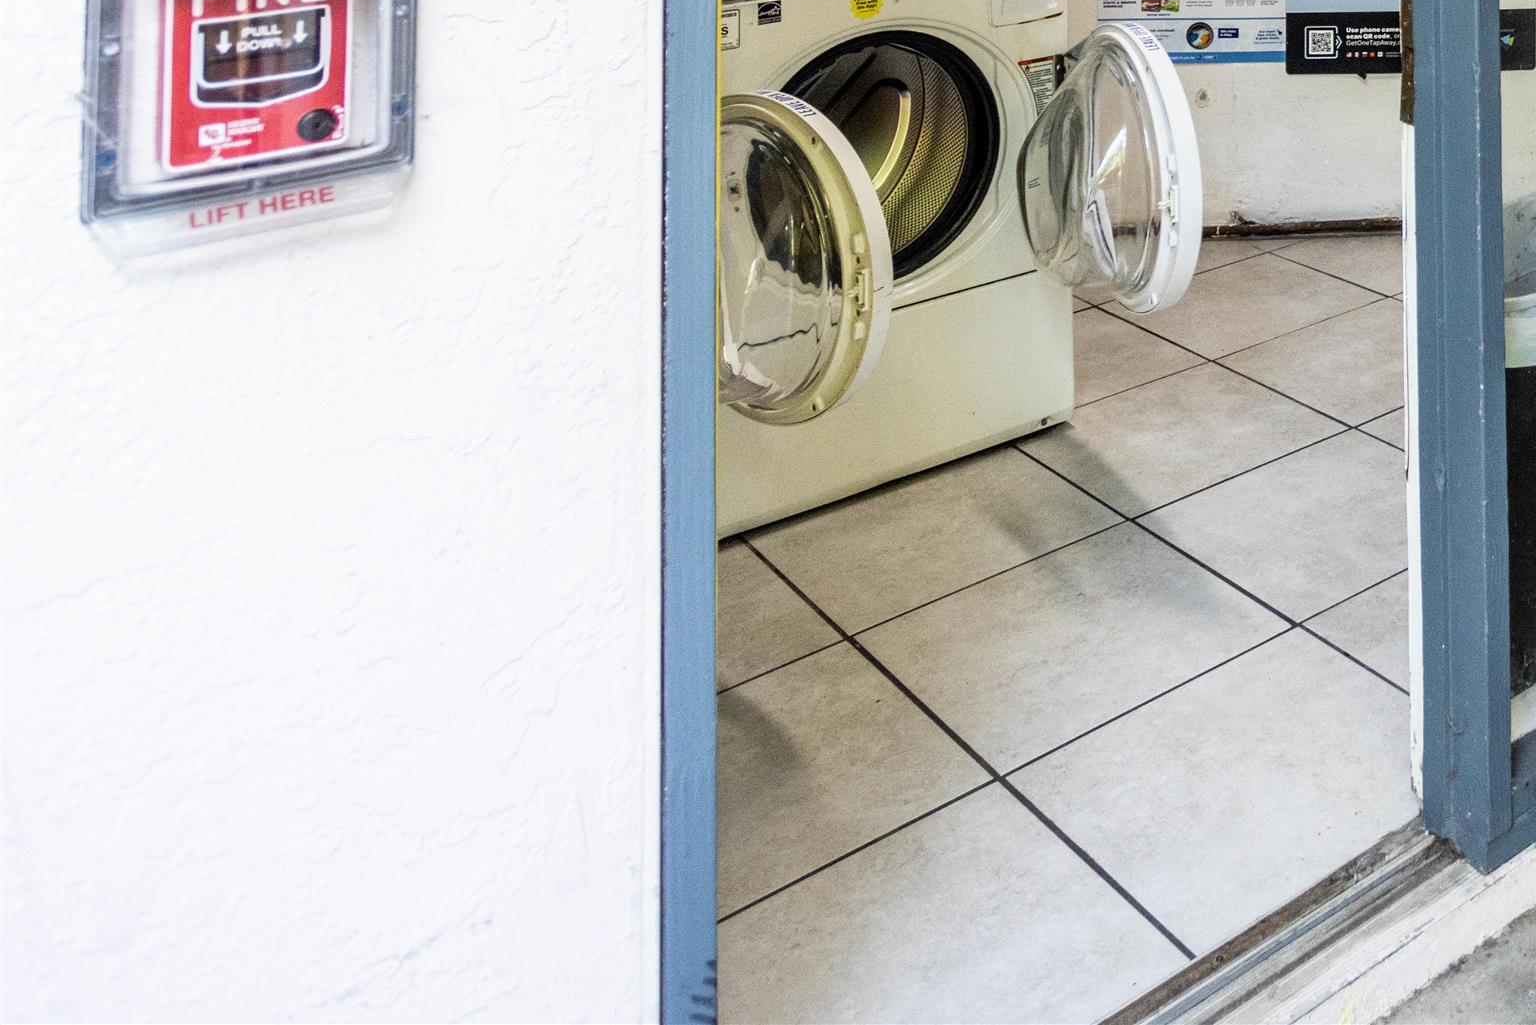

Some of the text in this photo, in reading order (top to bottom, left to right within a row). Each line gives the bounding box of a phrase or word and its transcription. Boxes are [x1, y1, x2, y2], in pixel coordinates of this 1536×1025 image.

[241, 24, 282, 38] PULL
[189, 185, 335, 228] LIFT HERE
